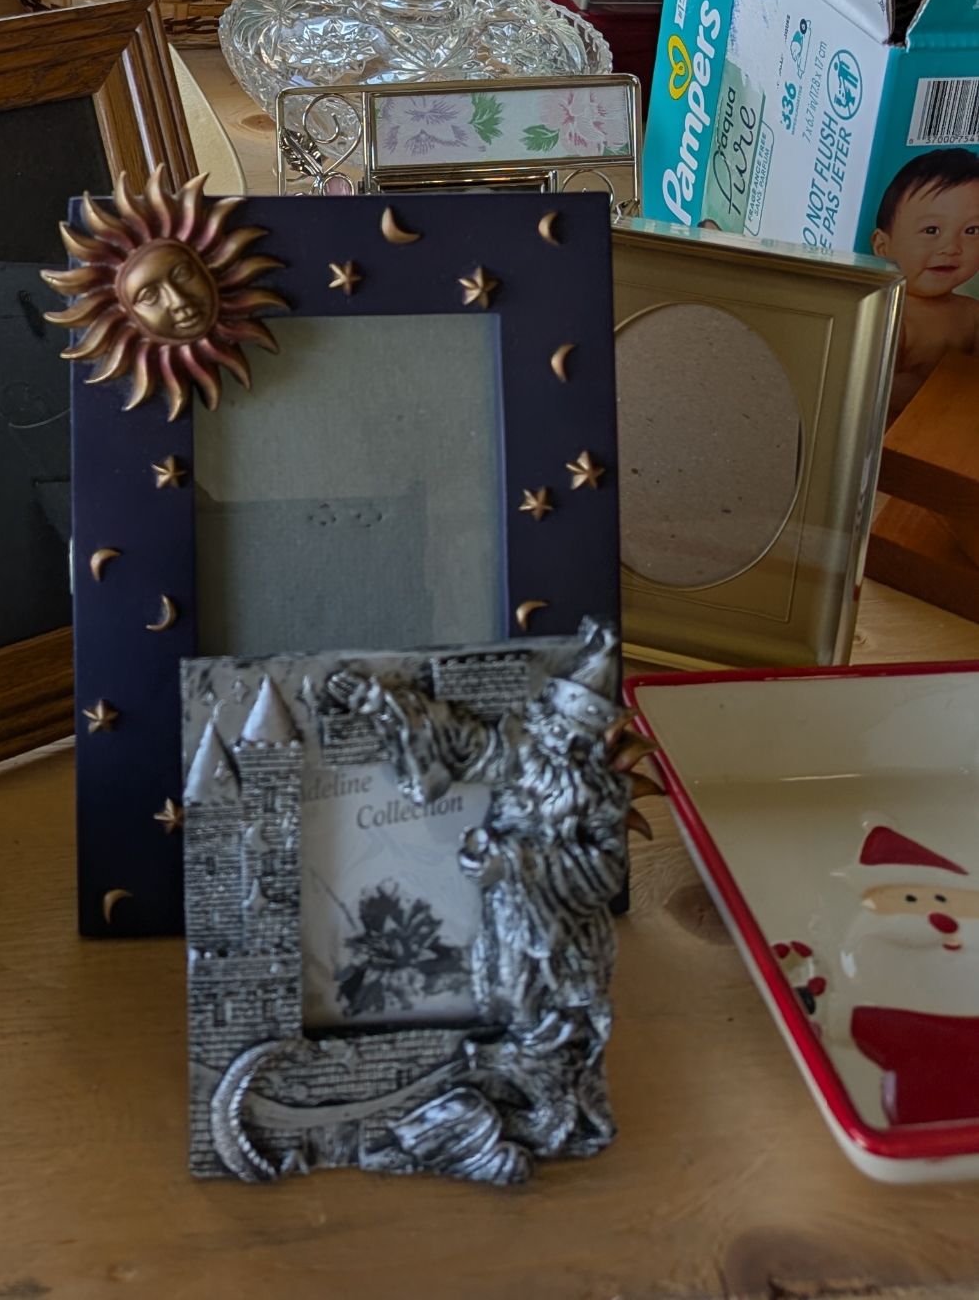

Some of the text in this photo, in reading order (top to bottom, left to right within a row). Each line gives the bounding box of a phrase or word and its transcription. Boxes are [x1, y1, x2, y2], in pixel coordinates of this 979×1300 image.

[818, 41, 828, 59] cm
[662, 0, 721, 226] Pampers
[719, 86, 737, 149] aqua
[748, 132, 767, 222] FRAGRANCE FREE
[754, 148, 770, 217] SANS PARFUM
[802, 111, 839, 247] O NOT FLUSH
[819, 127, 853, 250] E PAS JETER
